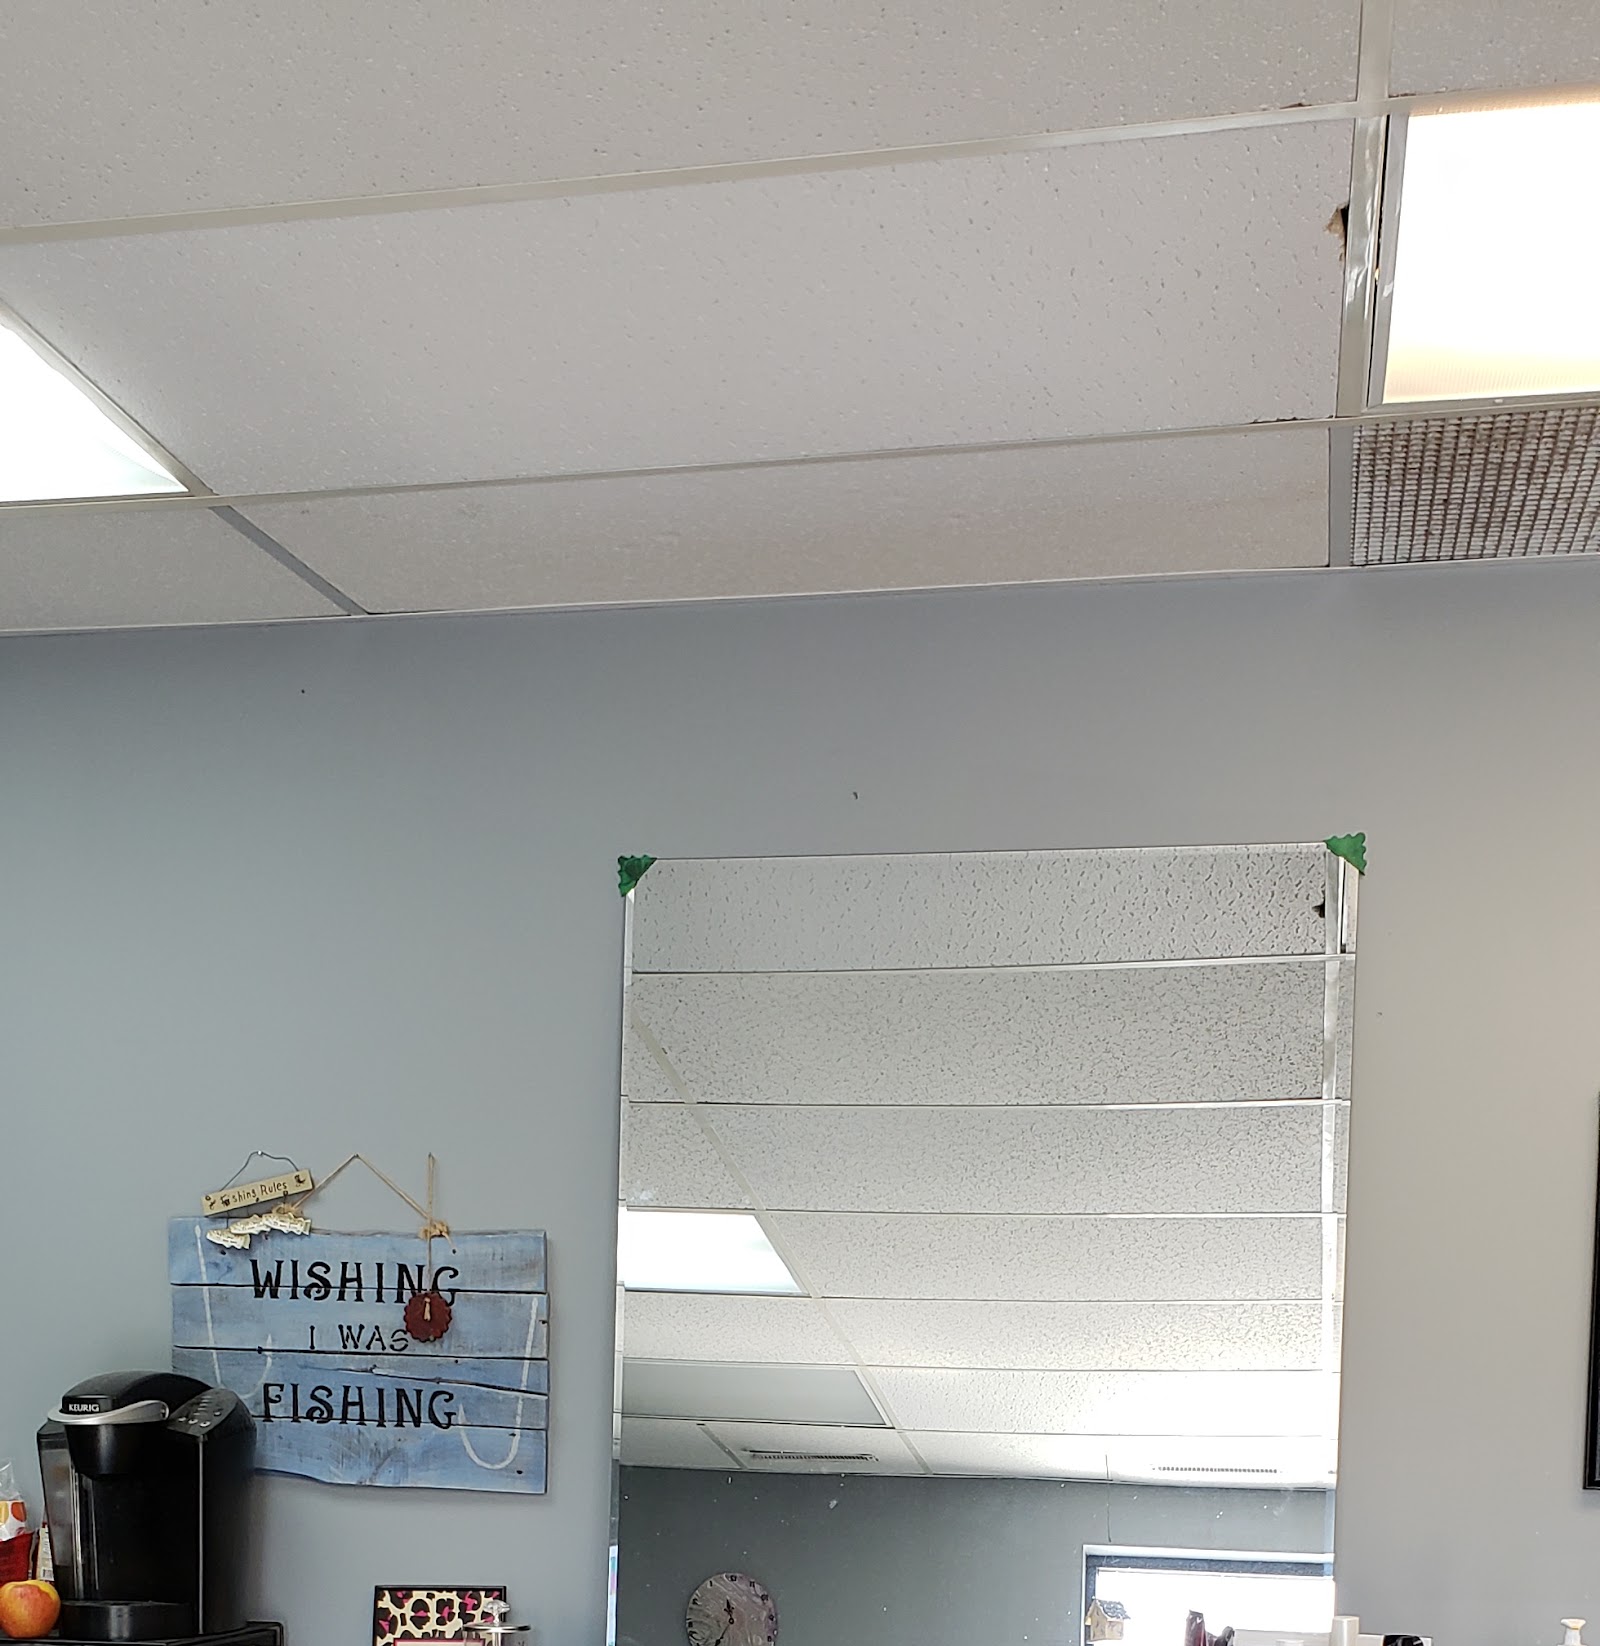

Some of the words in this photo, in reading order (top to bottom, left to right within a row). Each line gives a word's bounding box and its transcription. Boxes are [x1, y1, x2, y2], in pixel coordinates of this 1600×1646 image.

[220, 1189, 257, 1207] Fishing
[260, 1181, 288, 1196] Rules
[249, 1258, 459, 1307] WISHING
[309, 1325, 316, 1350] I
[338, 1324, 409, 1351] WAS
[68, 1403, 100, 1413] KEURIG
[262, 1383, 457, 1430] FISHING
